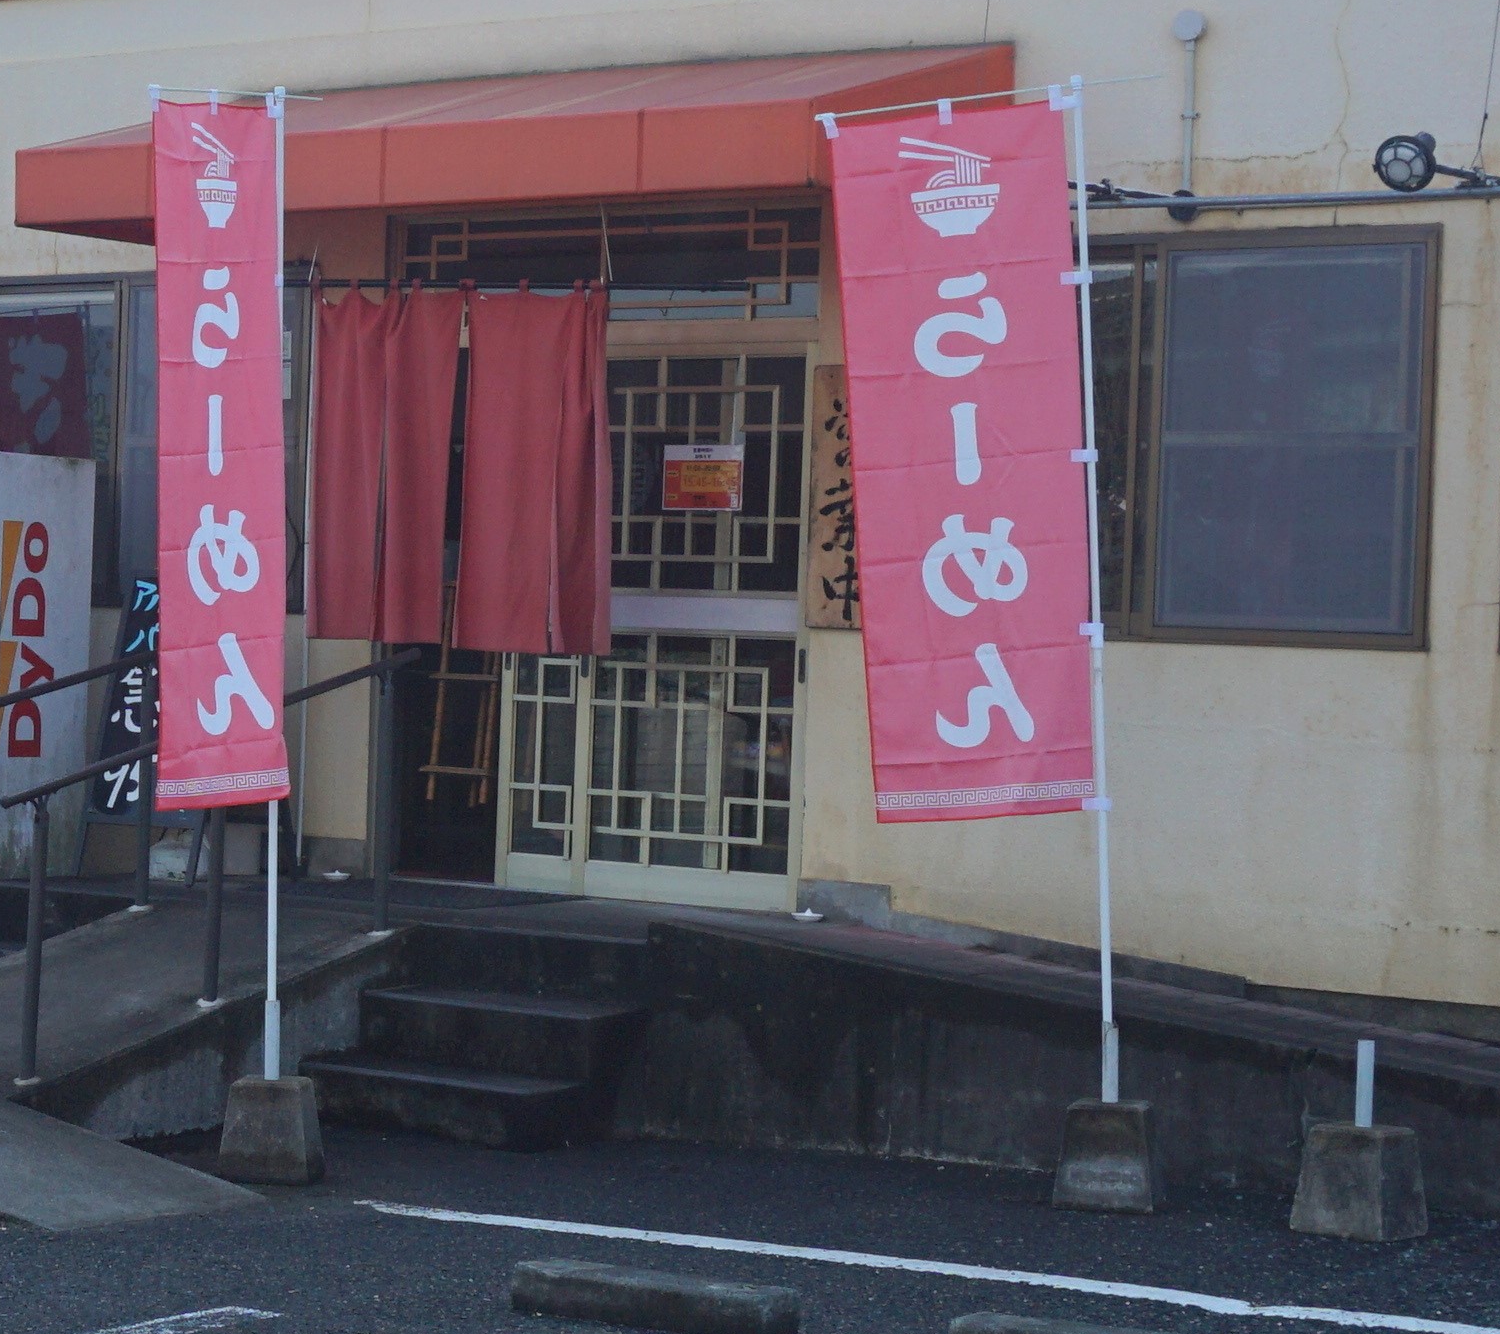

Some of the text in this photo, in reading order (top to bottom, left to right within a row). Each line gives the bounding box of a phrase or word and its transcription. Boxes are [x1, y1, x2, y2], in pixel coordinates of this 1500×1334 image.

[185, 266, 278, 736] らーめん
[911, 270, 1038, 749] らーめん
